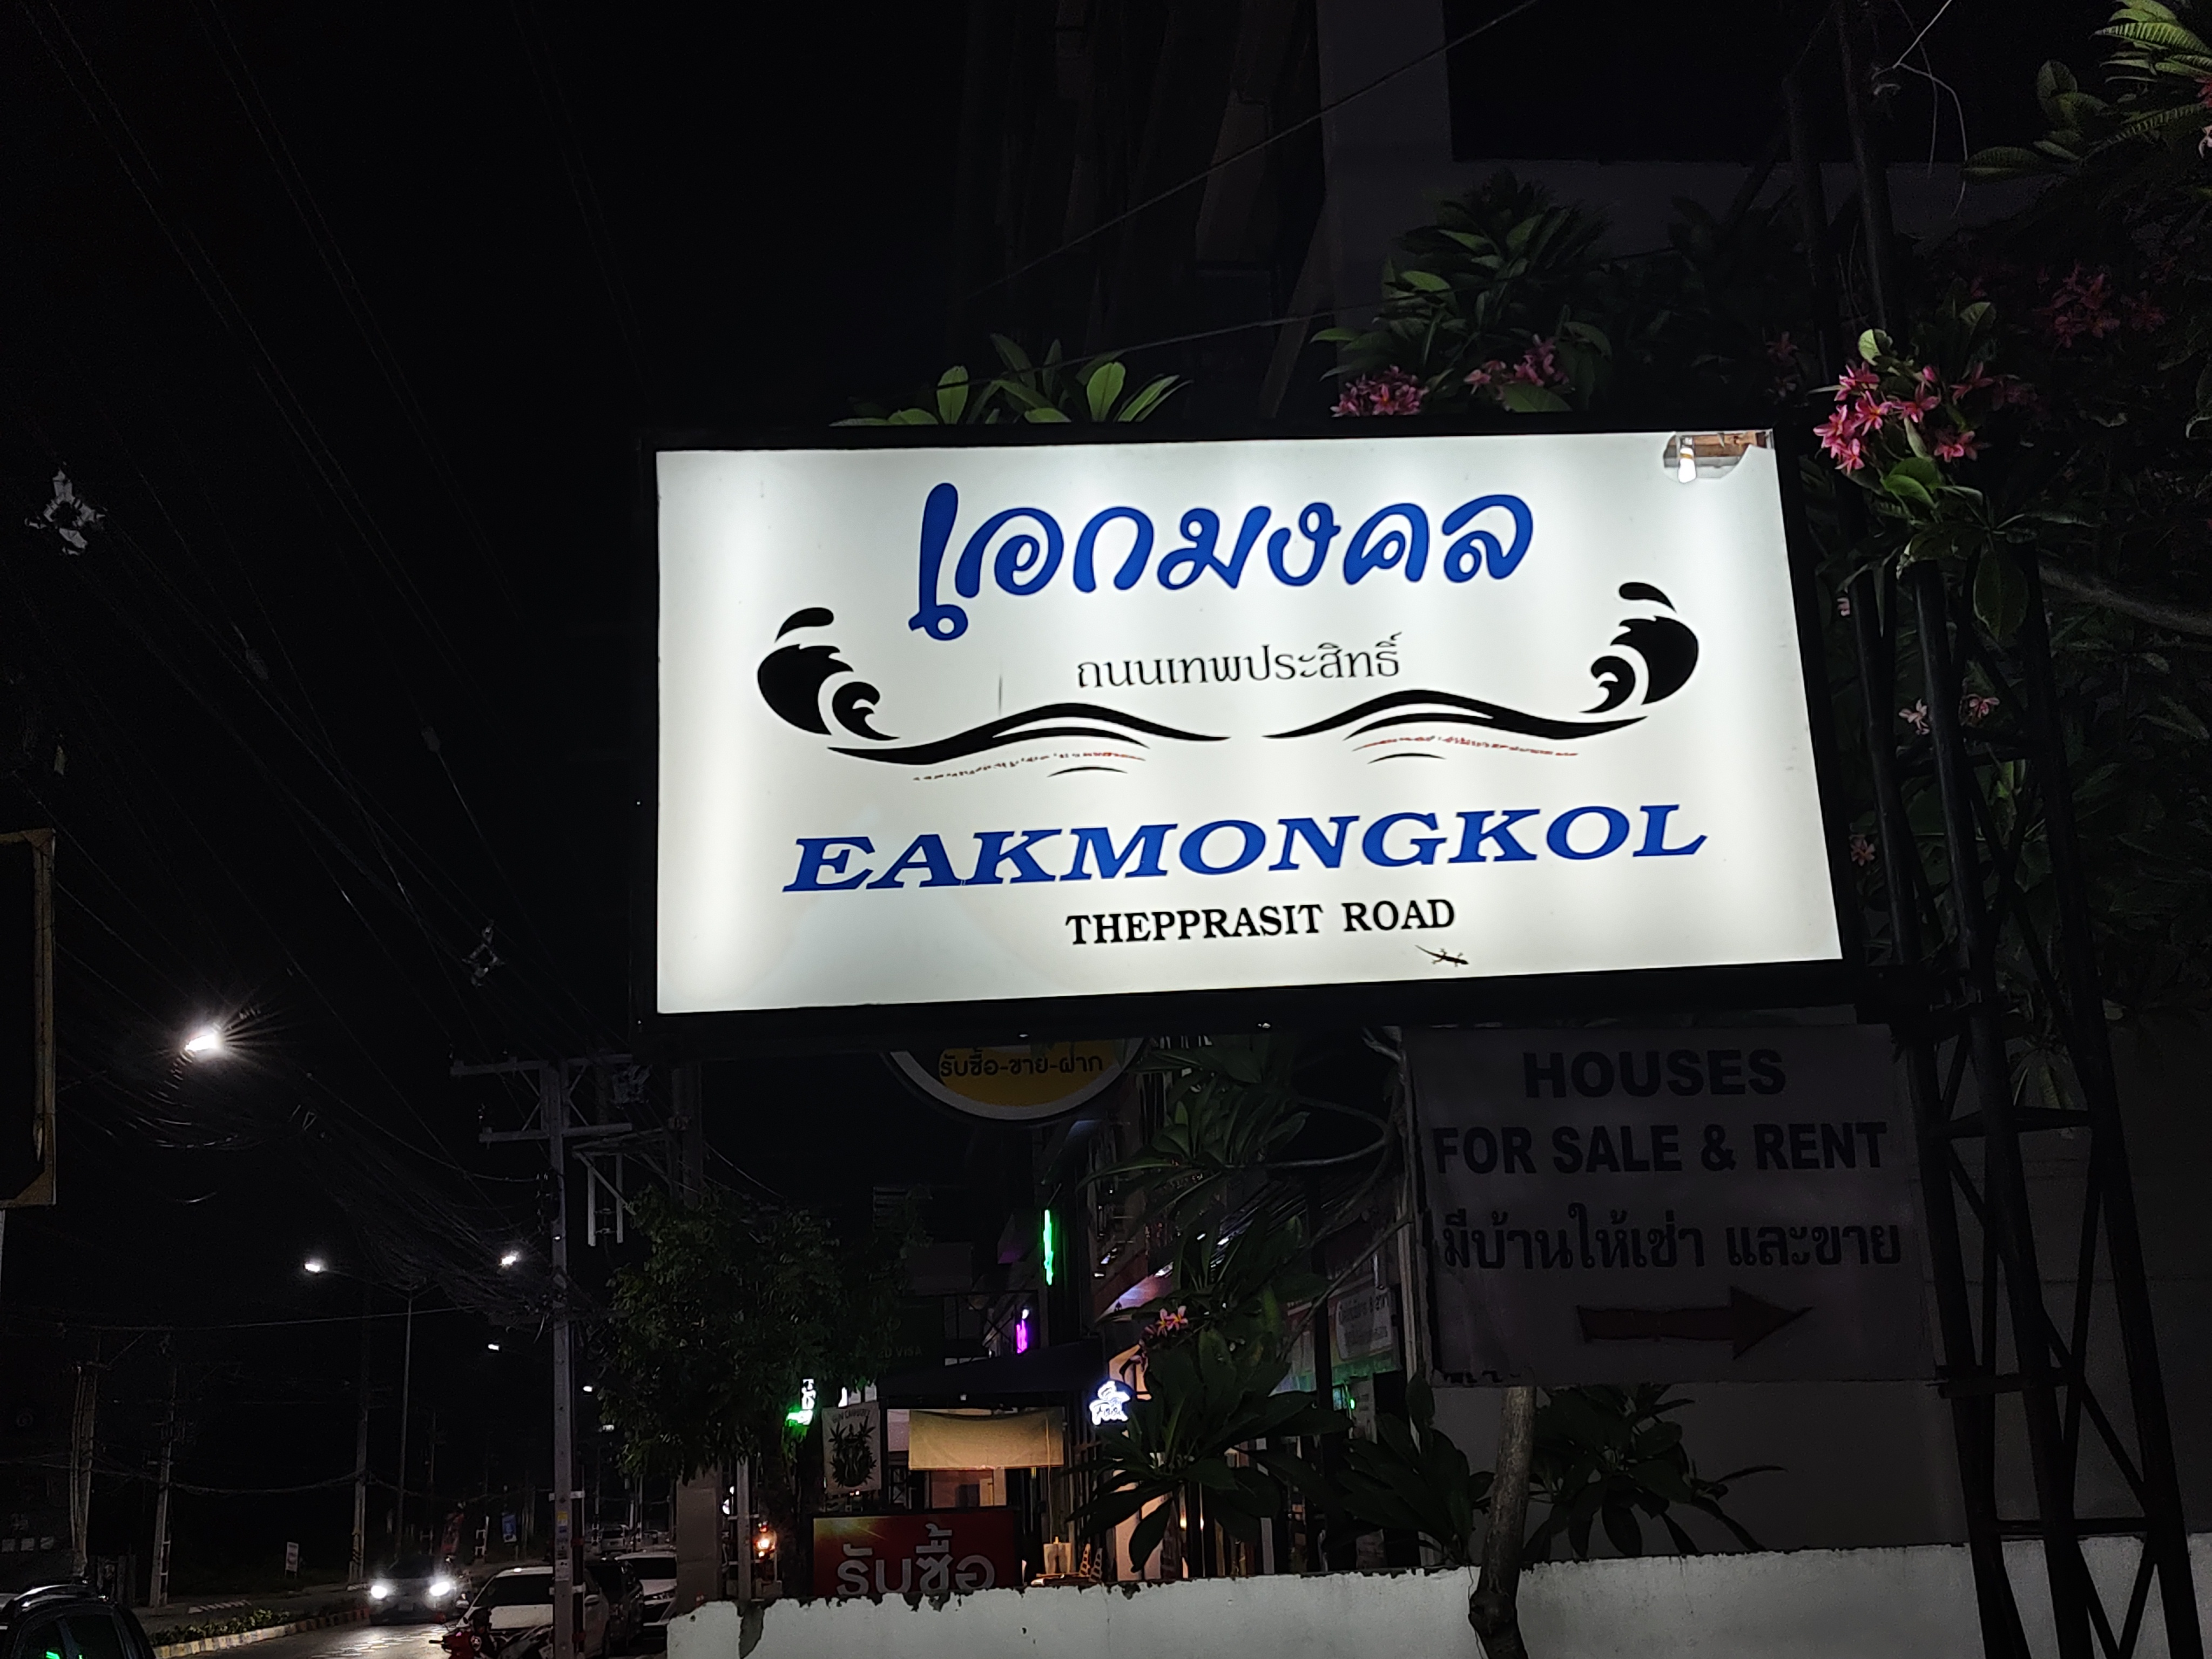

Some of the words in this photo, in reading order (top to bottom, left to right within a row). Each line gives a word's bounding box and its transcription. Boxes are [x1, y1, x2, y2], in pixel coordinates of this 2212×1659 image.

[908, 482, 1533, 642] เอกมงคล
[1078, 632, 1402, 687] ถนนเทพประสิทธิ์
[783, 805, 1707, 892] EAKMONGKOL
[1065, 905, 1323, 946] THEPPRASIT
[1341, 899, 1455, 932] ROAD
[1523, 1048, 1786, 1098] HOUSES
[1432, 1126, 1537, 1175] FOR
[1552, 1124, 1683, 1175] SALE
[1701, 1123, 1737, 1172] &
[1753, 1121, 1888, 1171] RENT
[1442, 1202, 1705, 1270] มีบ้านให้เช่า
[1727, 1224, 1902, 1267] และขาย
[835, 1522, 996, 1596] รับซื้อ
